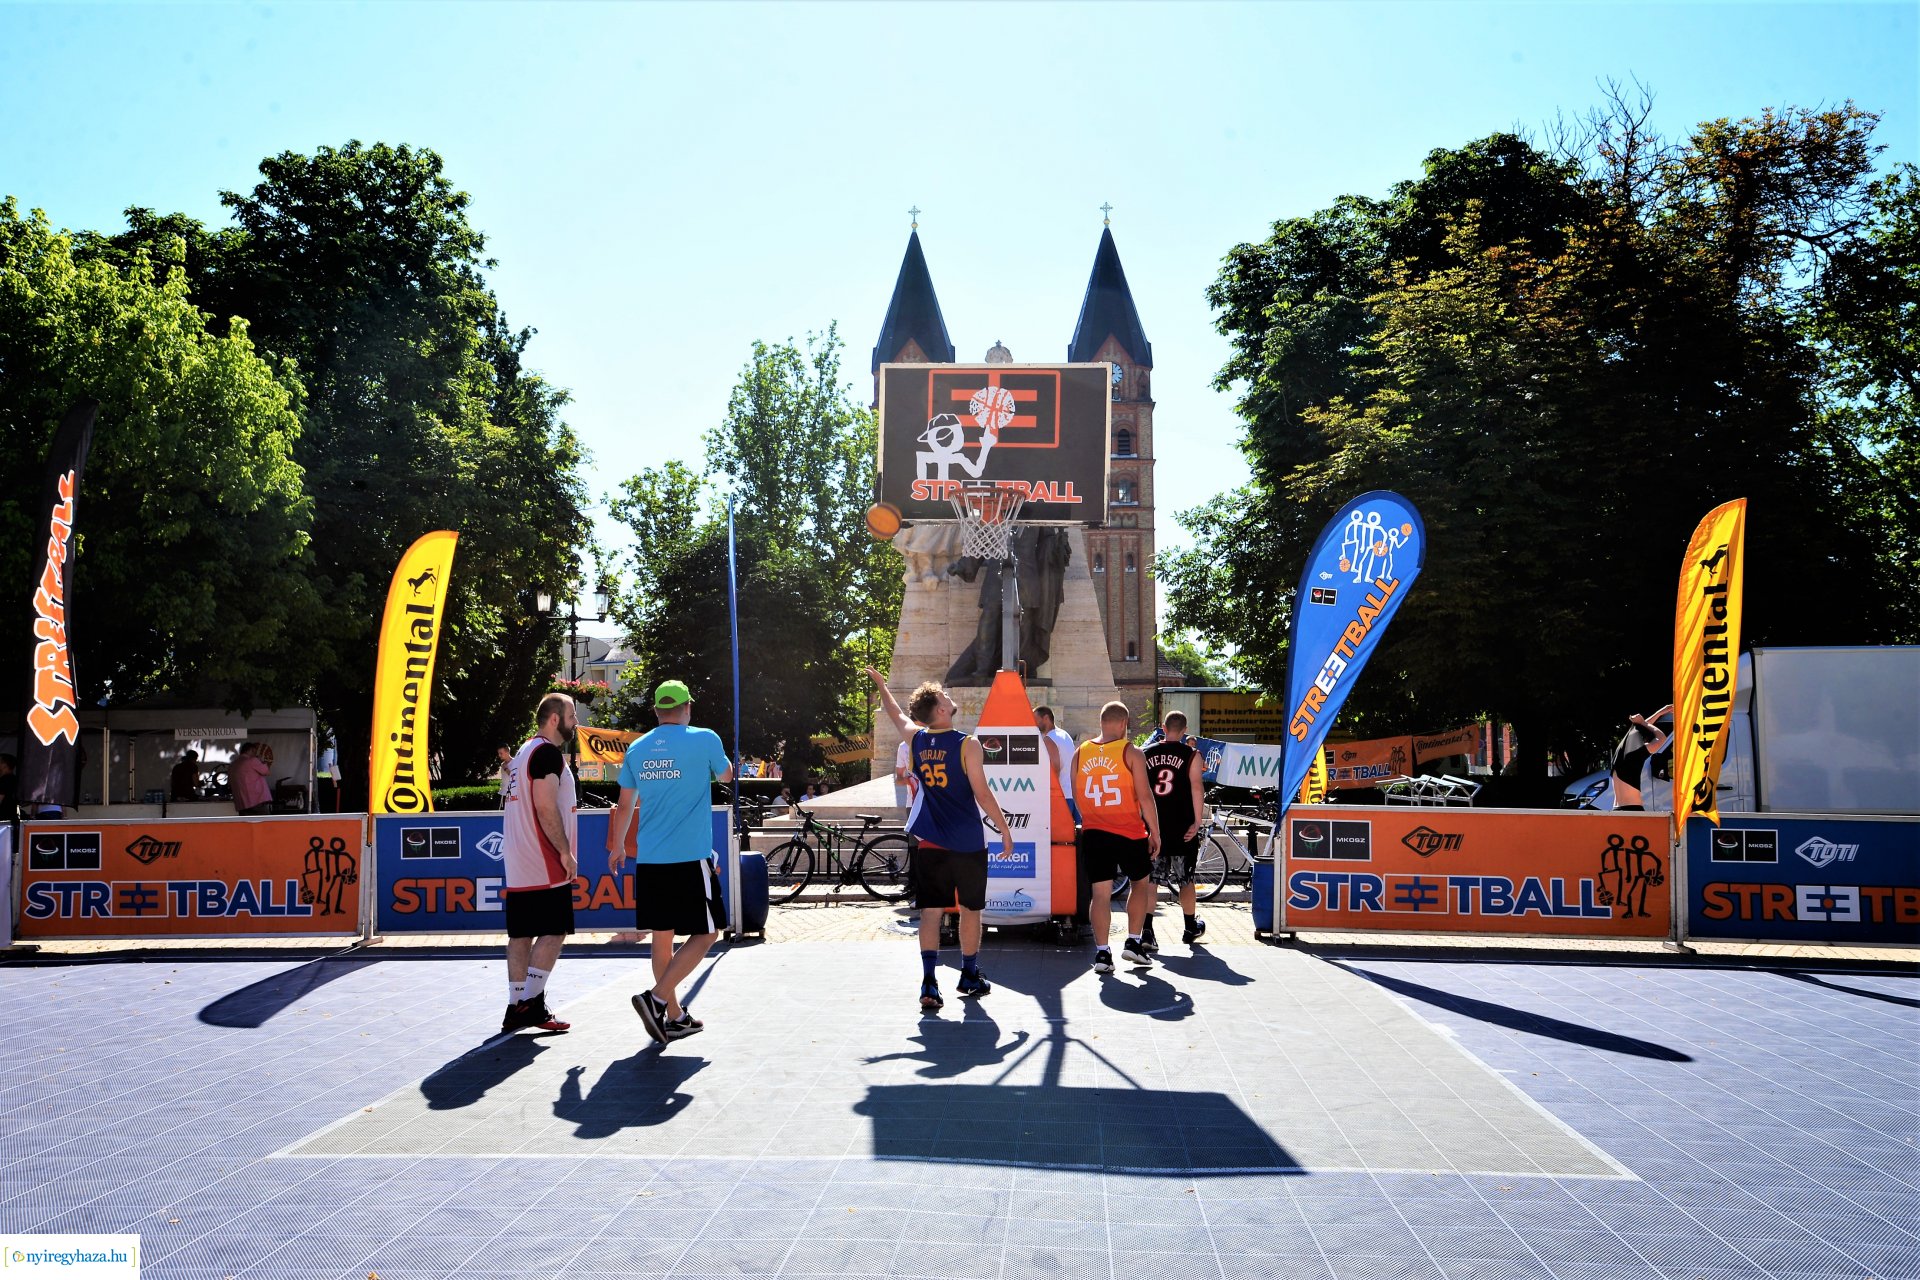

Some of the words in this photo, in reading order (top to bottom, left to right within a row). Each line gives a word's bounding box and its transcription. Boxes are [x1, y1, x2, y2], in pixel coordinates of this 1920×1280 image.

[1289, 577, 1400, 743] STREETBALL
[177, 728, 237, 737] VERSENYIRODA
[642, 759, 674, 770] COURT
[1081, 757, 1118, 775] MITCHELL
[1146, 754, 1184, 770] IVERSON
[639, 769, 682, 781] MONITOR
[920, 763, 949, 788] 35
[1155, 769, 1175, 796] 3
[1084, 774, 1122, 807] 45
[138, 840, 182, 858] TOTI
[1336, 836, 1366, 844] MKOSZ
[1414, 831, 1465, 852] TOTI
[1808, 843, 1860, 862] TOTI
[985, 899, 1032, 908] rimavera
